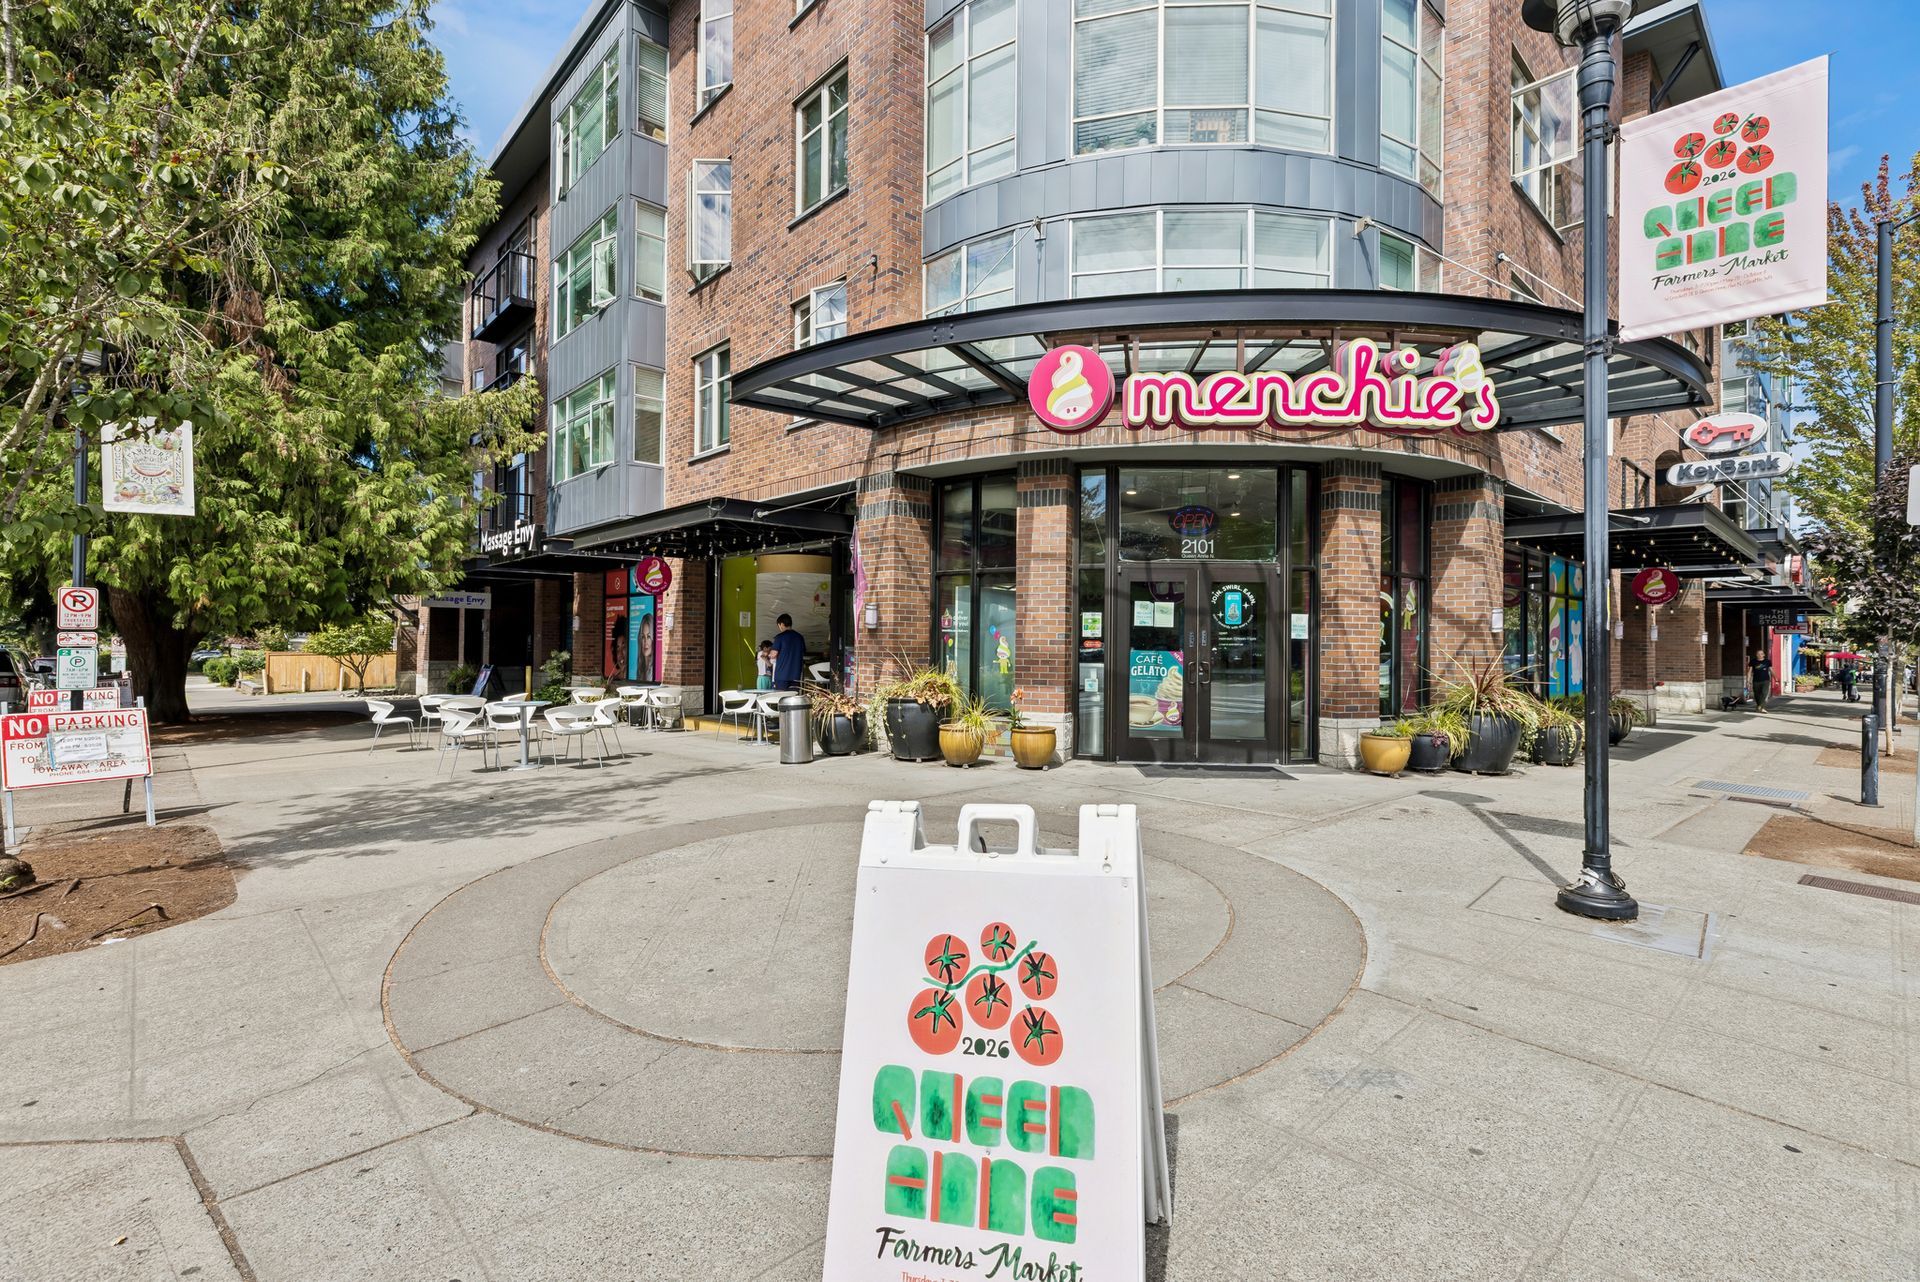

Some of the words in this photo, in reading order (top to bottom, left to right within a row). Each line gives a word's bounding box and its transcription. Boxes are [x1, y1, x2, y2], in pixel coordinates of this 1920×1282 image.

[1703, 169, 1736, 186] 2026
[1644, 172, 1797, 239] QUEEN
[1656, 212, 1784, 271] ANNE
[1652, 267, 1719, 290] Farmers
[1719, 249, 1788, 275] Market
[1129, 339, 1499, 428] menchie's
[1677, 455, 1780, 481] KeyBank
[1173, 512, 1214, 529] OPEN
[480, 530, 513, 556] Massage
[514, 520, 536, 553] Envy
[1181, 539, 1214, 554] 2101
[466, 595, 486, 605] Envy
[1135, 654, 1163, 664] CAFÉ
[1130, 665, 1167, 677] GELATO
[33, 692, 55, 705] NO
[62, 691, 114, 701] PKING
[9, 718, 43, 737] NO
[55, 713, 138, 731] PARKING
[9, 742, 43, 751] FROM
[32, 763, 90, 774] TOW-AWAY
[100, 759, 127, 768] AREA
[962, 1036, 1010, 1058] 2026
[872, 1064, 1095, 1160] QUEEN
[884, 1144, 1077, 1244] ANNE
[875, 1226, 978, 1269] Farmers
[978, 1242, 1083, 1282] Market
